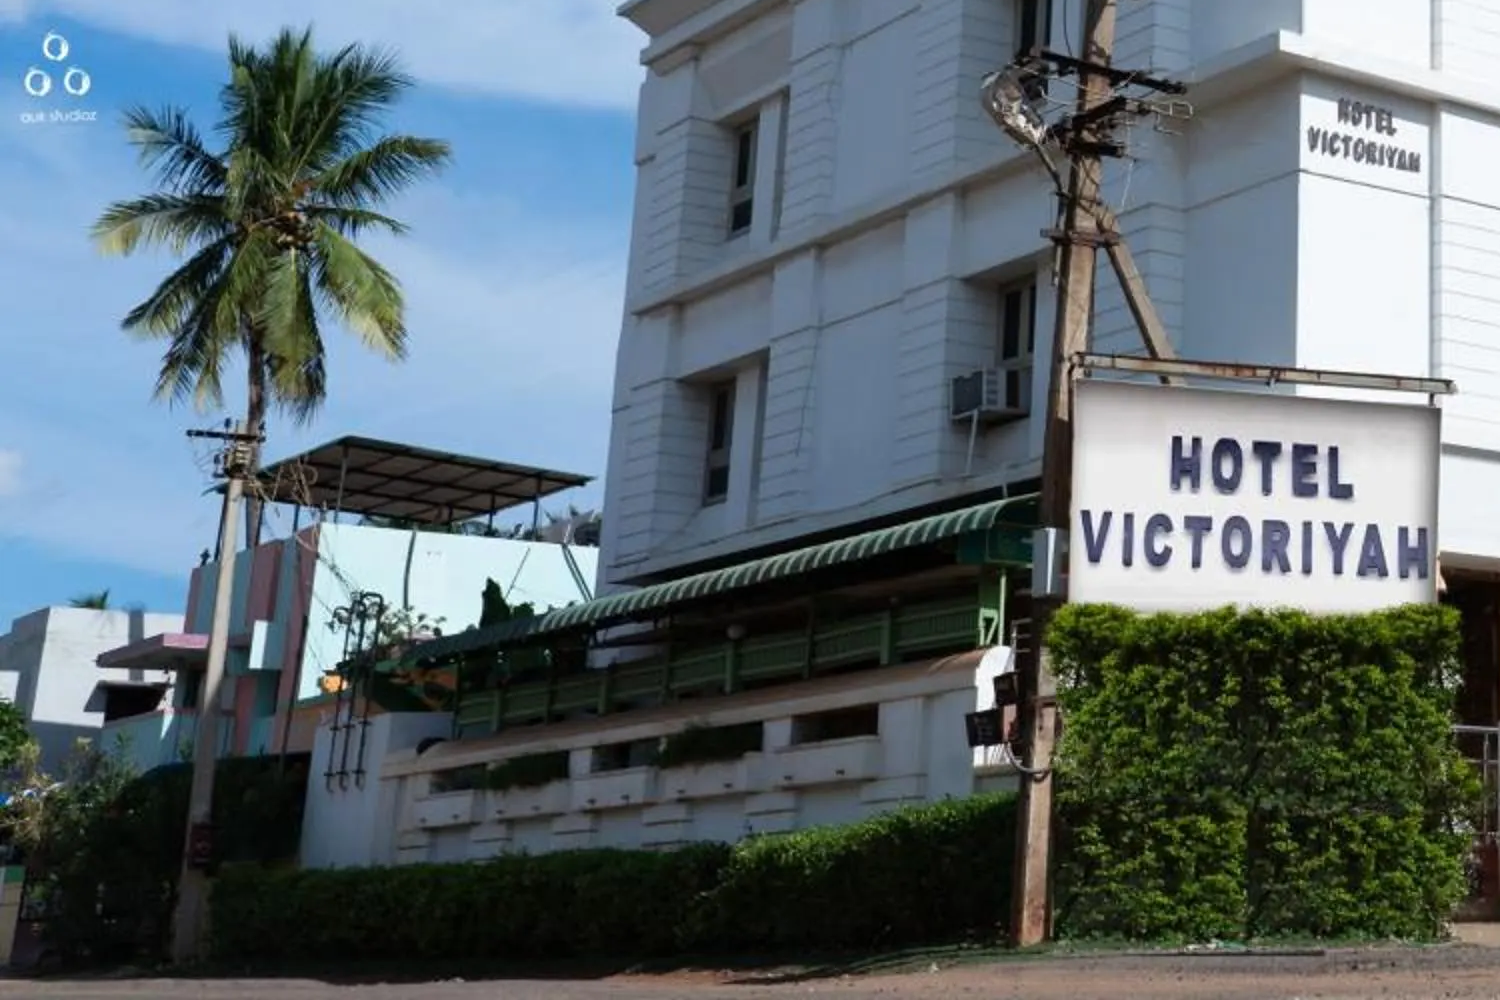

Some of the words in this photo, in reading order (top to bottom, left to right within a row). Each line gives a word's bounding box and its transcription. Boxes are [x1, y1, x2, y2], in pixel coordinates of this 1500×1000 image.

[1337, 97, 1397, 137] HOTEL
[1307, 125, 1421, 174] VICTORIYAH
[1170, 435, 1355, 500] HOTEL
[1080, 509, 1429, 580] VICTORIYAH
